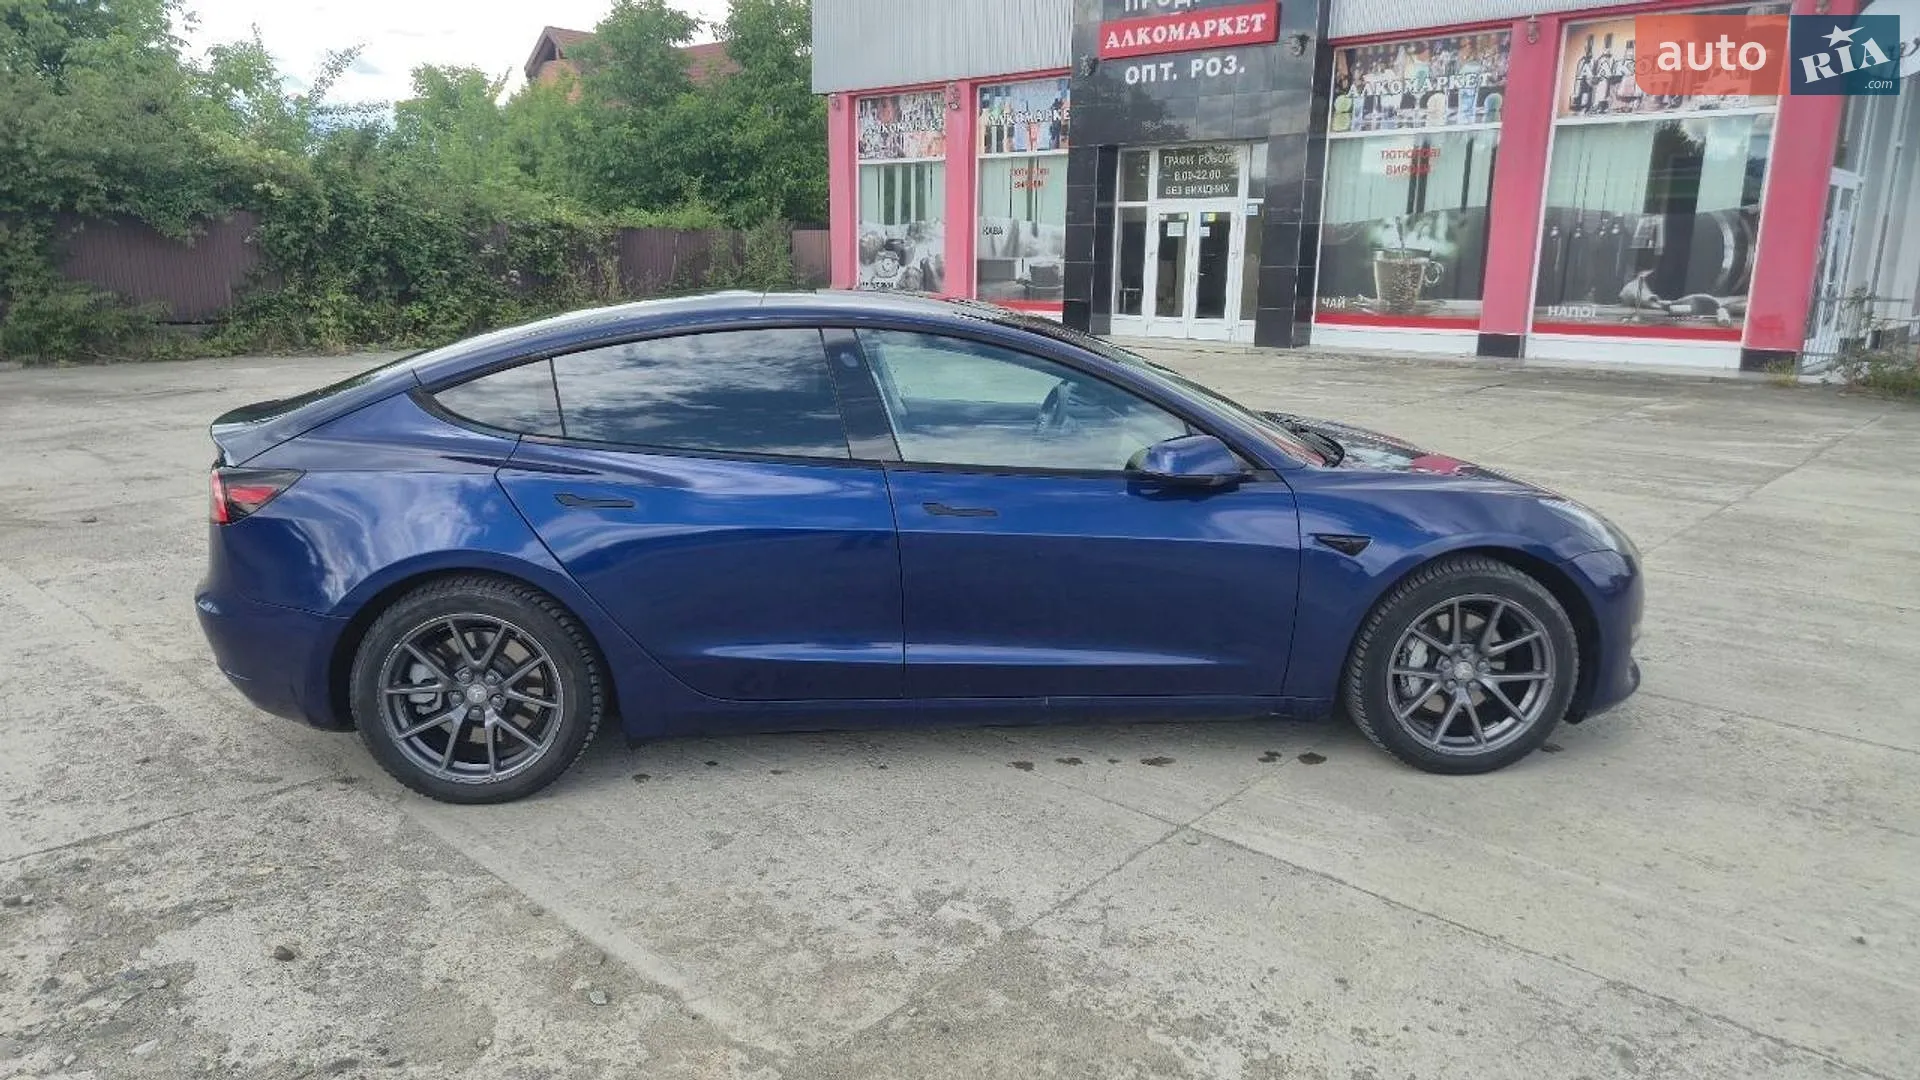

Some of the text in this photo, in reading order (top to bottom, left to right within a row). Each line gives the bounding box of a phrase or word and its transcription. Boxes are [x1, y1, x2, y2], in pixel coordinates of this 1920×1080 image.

[1105, 12, 1267, 49] АЛКОМАРКЕТ
[1125, 55, 1246, 85] ОПТ. РОЗ.
[1321, 295, 1346, 308] ЧАЙ
